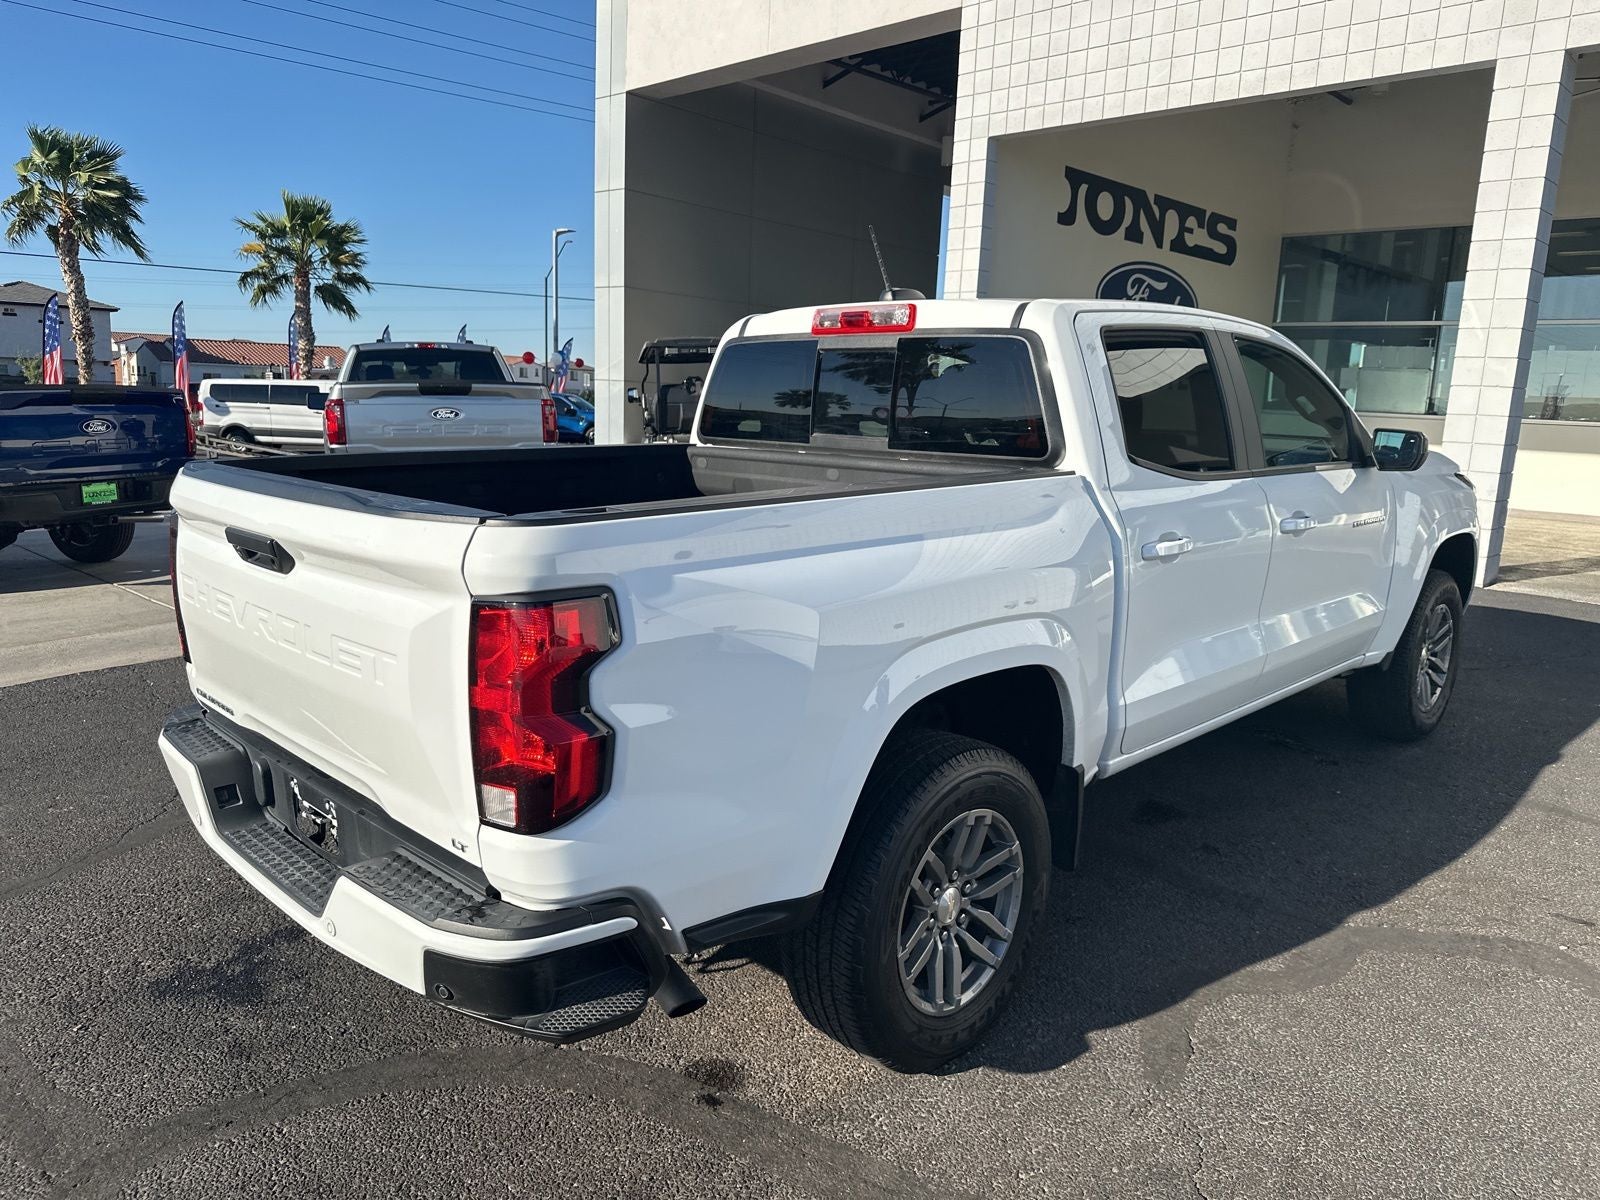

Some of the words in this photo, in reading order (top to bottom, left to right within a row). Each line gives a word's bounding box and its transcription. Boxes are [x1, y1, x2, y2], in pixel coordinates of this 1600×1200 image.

[1057, 165, 1237, 266] JONES
[87, 422, 108, 432] Ford
[84, 489, 116, 499] JONES
[182, 573, 397, 687] CHEVROLET
[451, 838, 469, 853] LT
